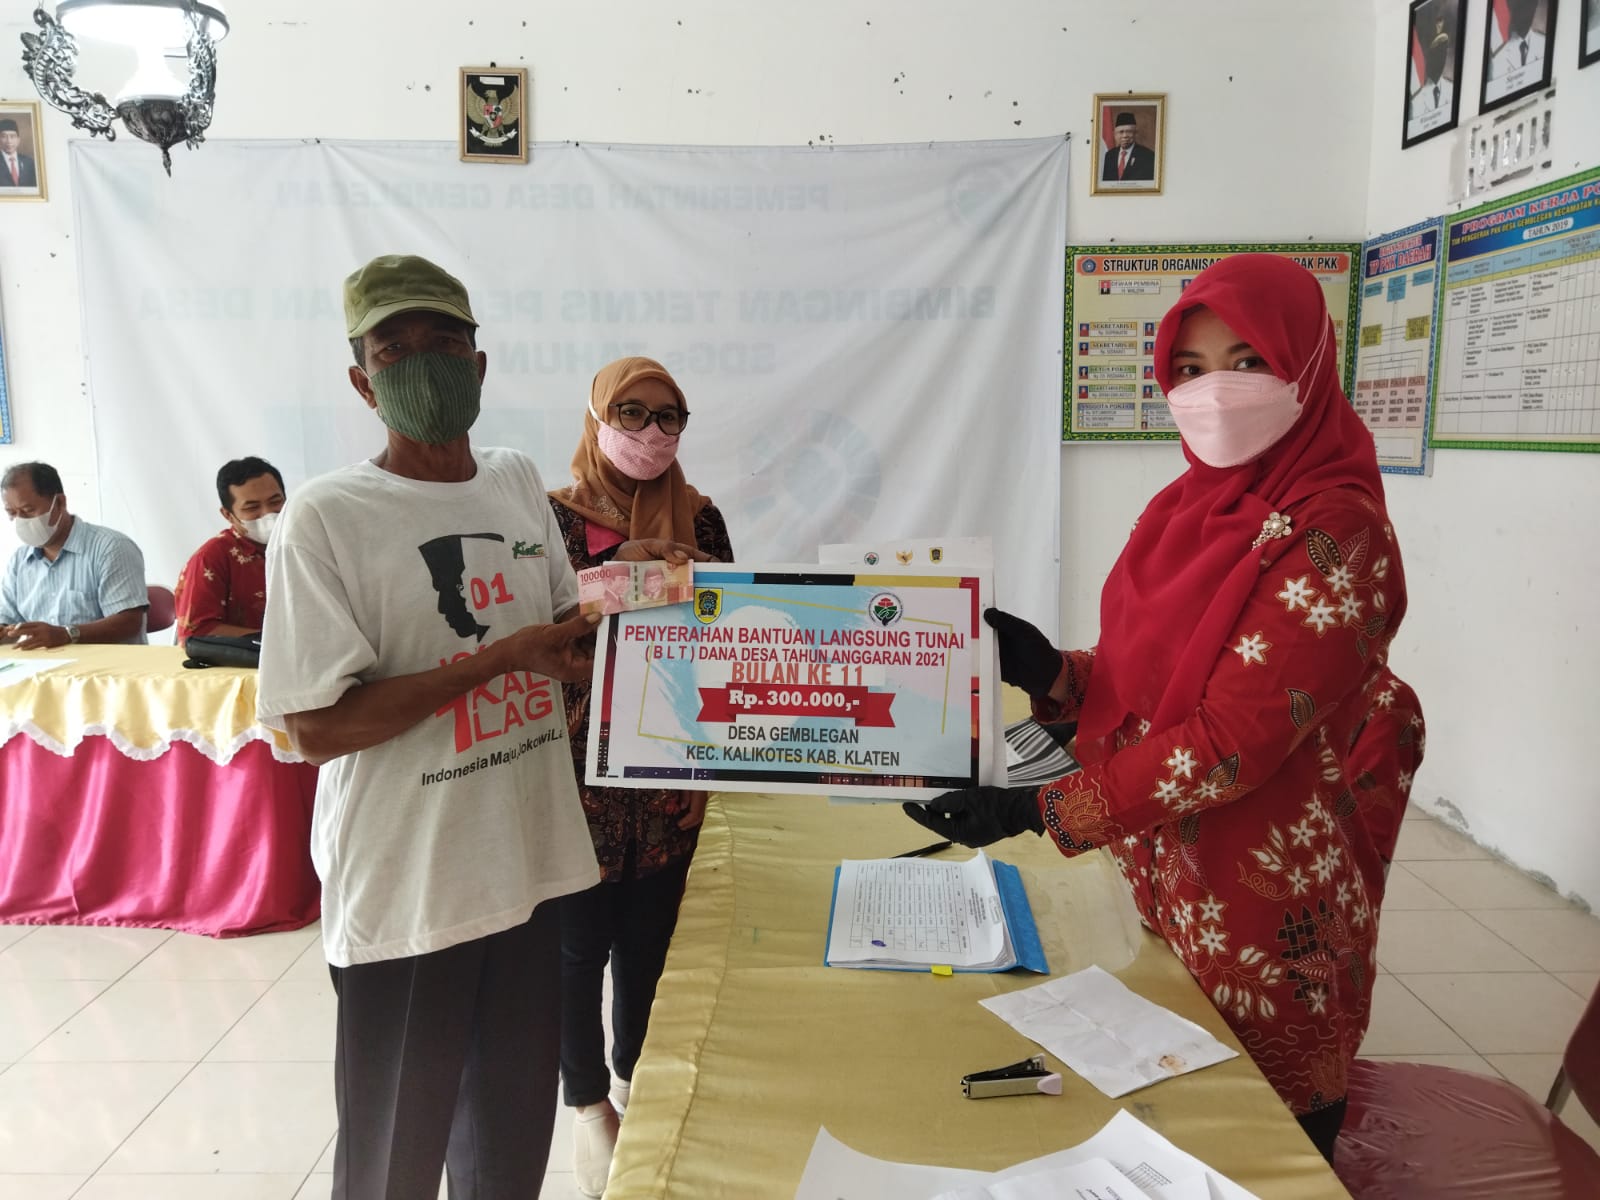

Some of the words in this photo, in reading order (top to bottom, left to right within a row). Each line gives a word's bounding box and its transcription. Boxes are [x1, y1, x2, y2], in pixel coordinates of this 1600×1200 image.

[1462, 205, 1526, 234] PROGRAM
[1529, 190, 1579, 214] KERJA
[1527, 223, 1551, 238] TAHUN
[1551, 218, 1569, 232] 2019
[1103, 259, 1159, 272] STRUKTUR
[1161, 258, 1222, 271] ORGANISA
[1317, 257, 1338, 269] PKK
[1397, 244, 1432, 267] DAERAH
[580, 568, 612, 584] 100000
[470, 572, 514, 610] 01
[624, 625, 734, 643] PENYERAHAN
[738, 627, 815, 645] BANTUAN
[820, 629, 911, 648] LANGSUNG
[915, 631, 964, 649] TUNAI
[699, 646, 738, 661] DANA
[741, 647, 779, 662] DESA
[782, 648, 828, 664] TAHUN
[831, 650, 912, 666] ANGGARAN
[915, 652, 945, 667] 2021
[731, 662, 799, 684] BULAN
[807, 663, 832, 685] KE
[841, 665, 863, 686] 11
[728, 726, 766, 741] DESA
[769, 727, 859, 743] GEMBLEGAN
[686, 745, 719, 761] KEC.
[723, 746, 803, 762] KALIKOTES
[807, 749, 840, 764] KAB.
[845, 750, 900, 766] KLATEN
[421, 757, 488, 786] Indonesia
